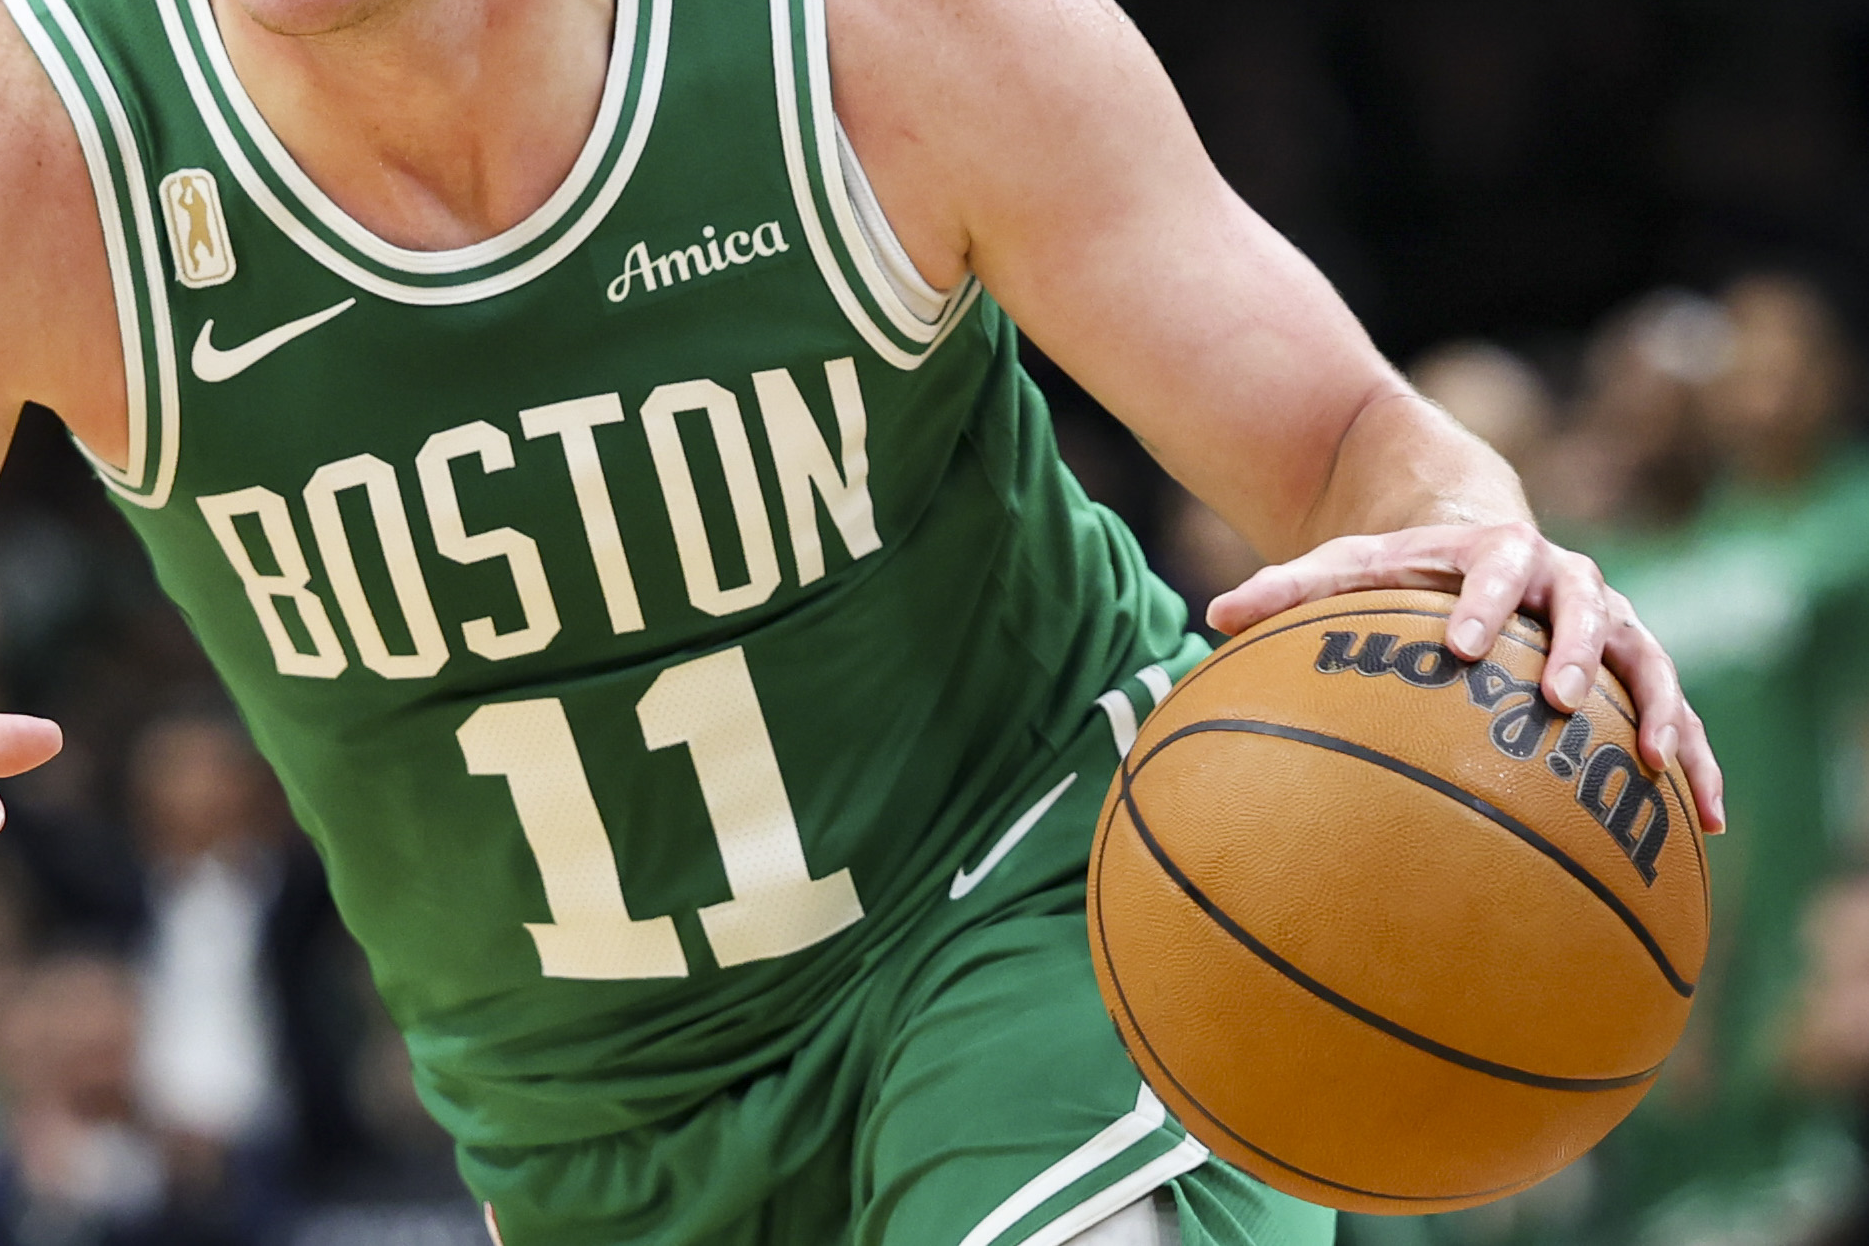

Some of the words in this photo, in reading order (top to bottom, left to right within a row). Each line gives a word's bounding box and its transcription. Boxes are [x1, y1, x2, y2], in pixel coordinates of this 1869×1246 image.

[606, 220, 790, 303] Amica
[195, 355, 883, 681] BOSTON
[454, 644, 866, 981] 11
[1313, 630, 1670, 888] Wilson
